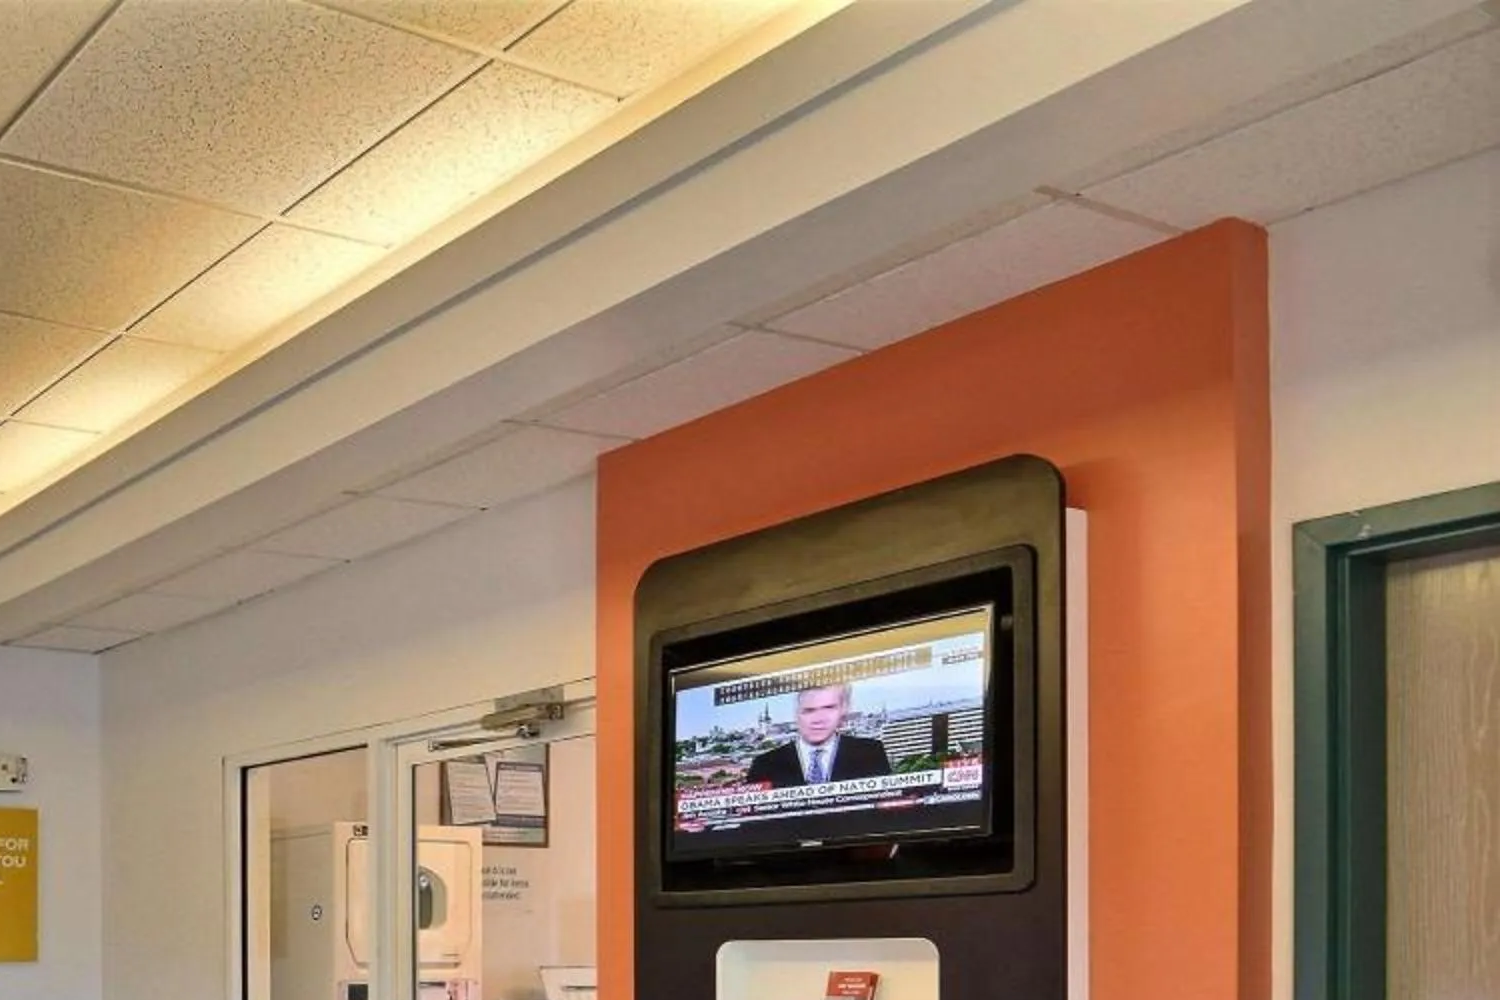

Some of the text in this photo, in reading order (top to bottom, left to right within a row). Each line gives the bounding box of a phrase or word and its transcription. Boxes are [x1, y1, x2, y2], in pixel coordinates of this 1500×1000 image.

[680, 798, 721, 811] OBAMA
[725, 793, 769, 806] SPEAKS
[772, 786, 815, 800] AHEAD
[817, 784, 836, 795] OF
[838, 779, 877, 792] NATO
[881, 773, 934, 789] SUMMIT
